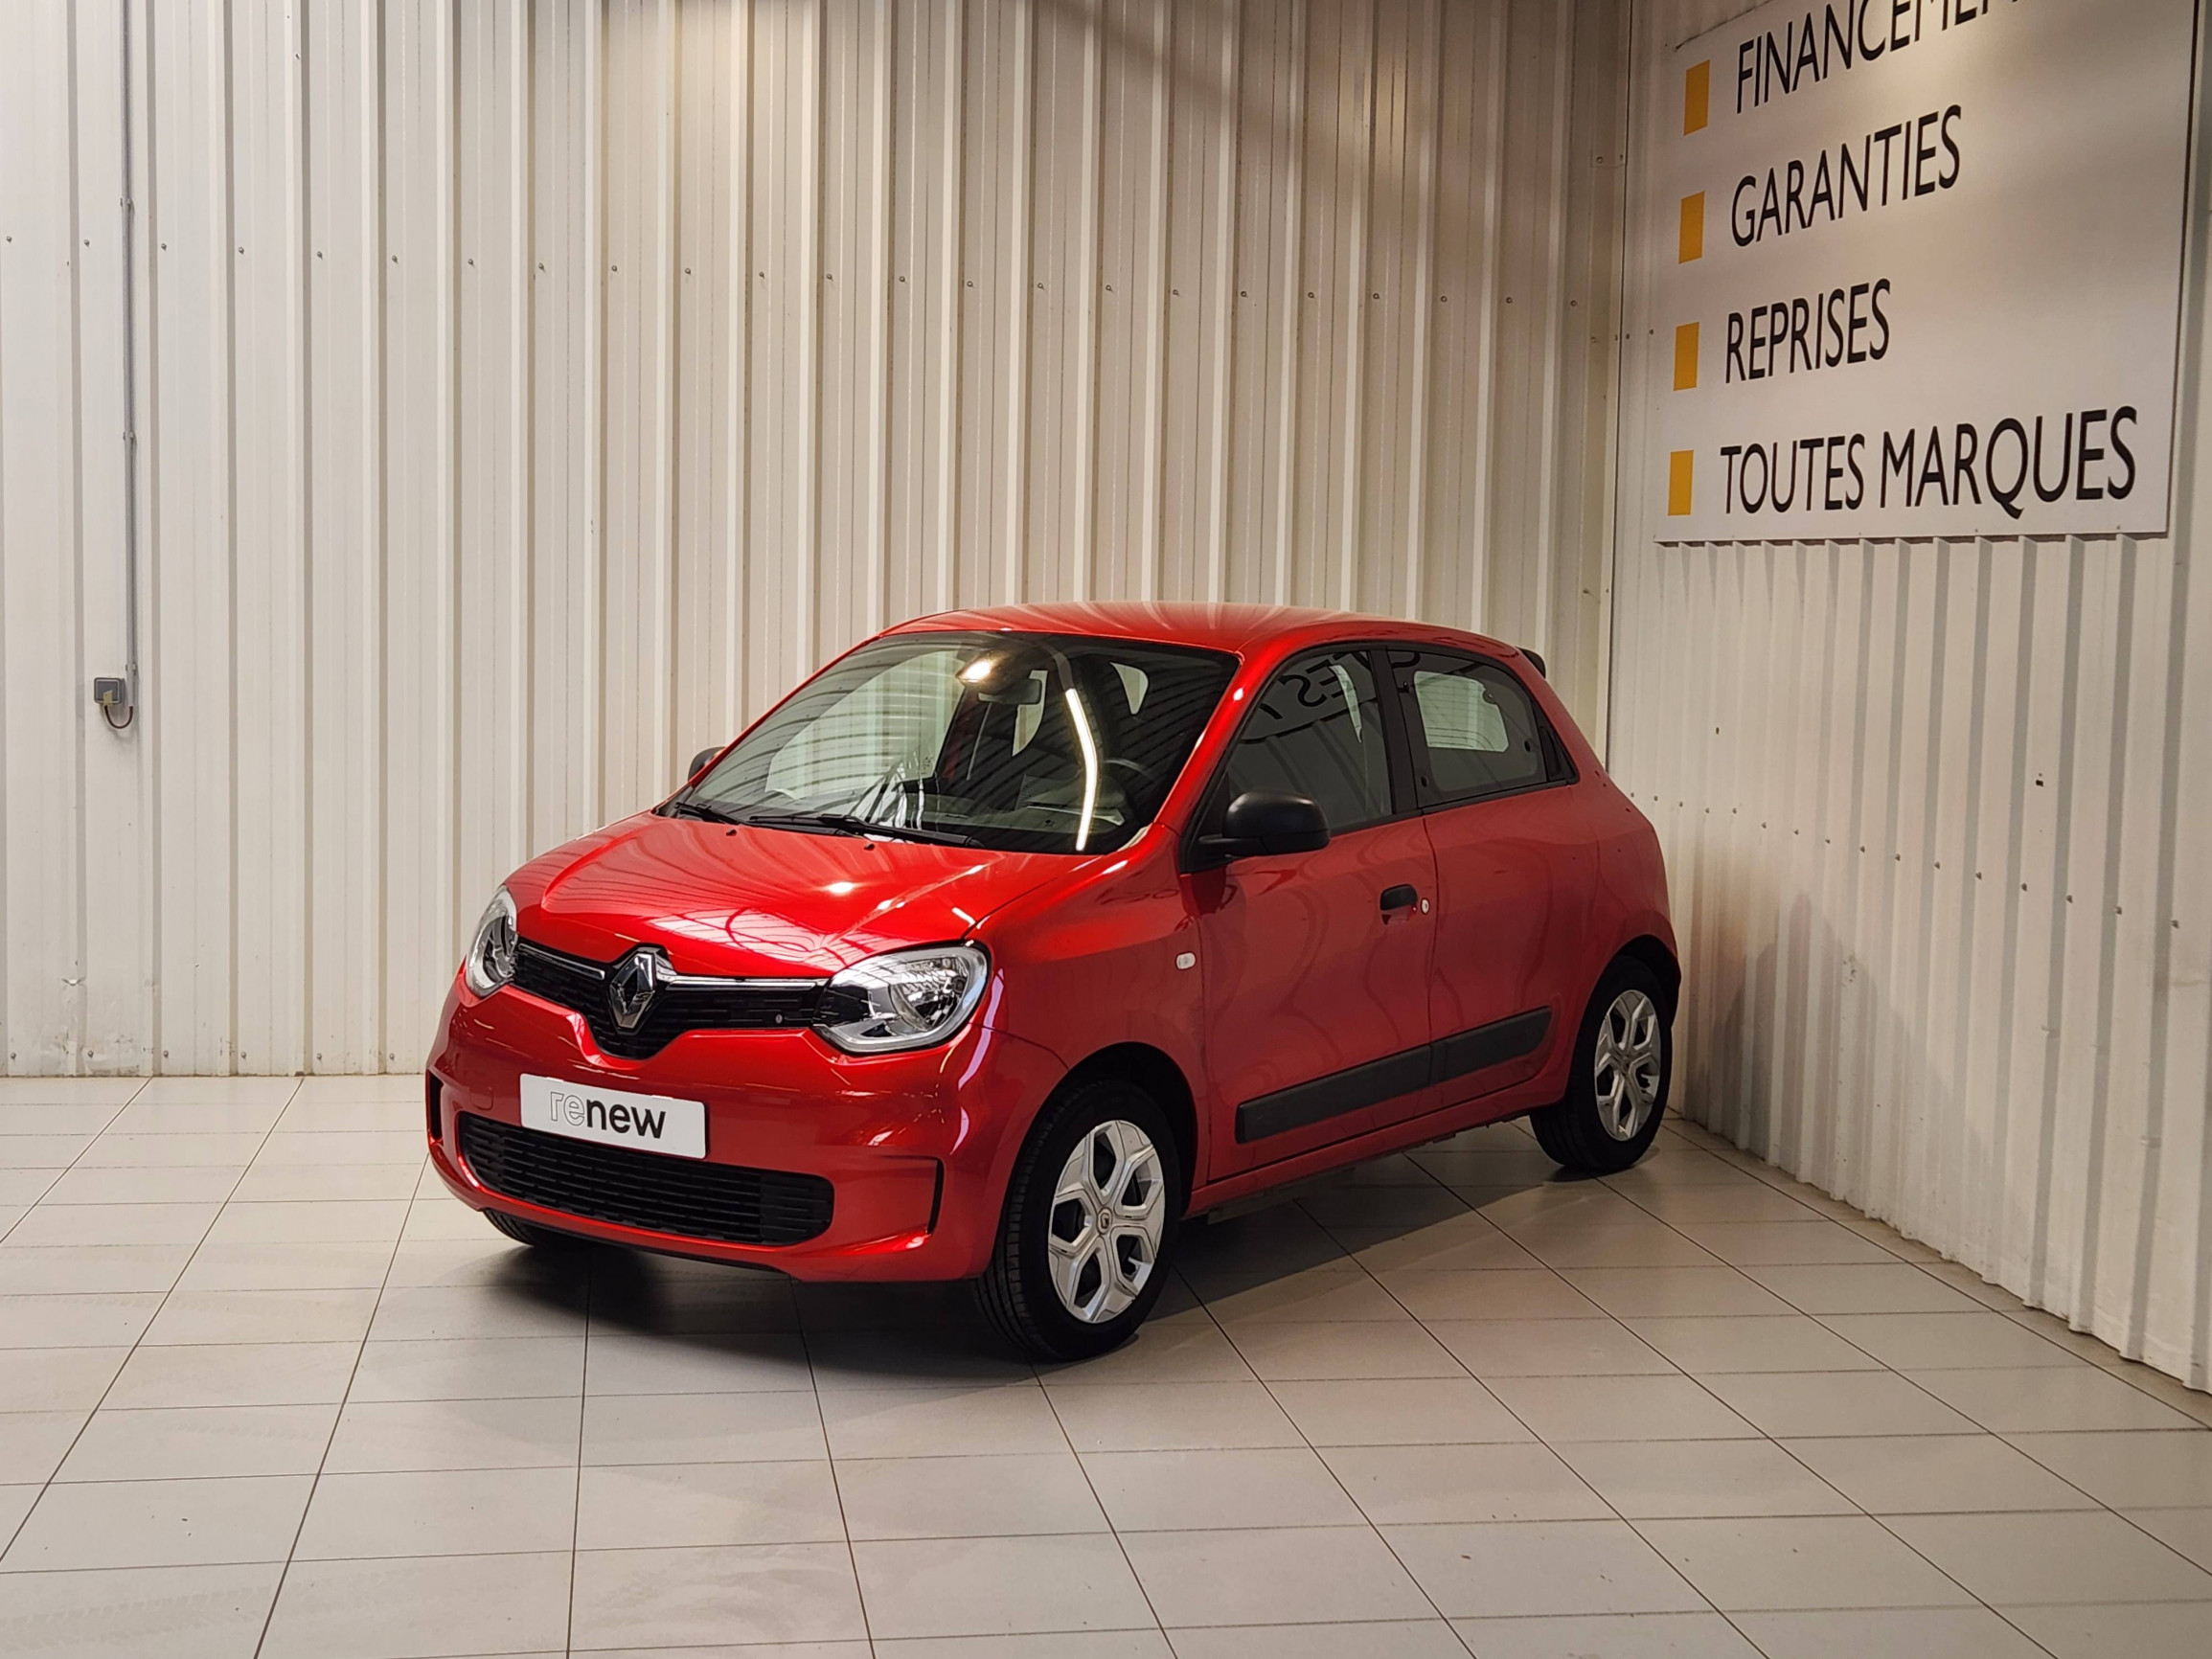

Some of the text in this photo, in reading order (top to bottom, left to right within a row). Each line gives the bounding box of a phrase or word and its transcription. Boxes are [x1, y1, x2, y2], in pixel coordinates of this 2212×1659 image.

[1736, 0, 2016, 114] FINANCE
[1731, 104, 1962, 247] GARANTIES
[1725, 278, 1891, 384] REPRISES
[1720, 405, 2137, 520] TOUTES MARQUES
[550, 1091, 667, 1139] renew
